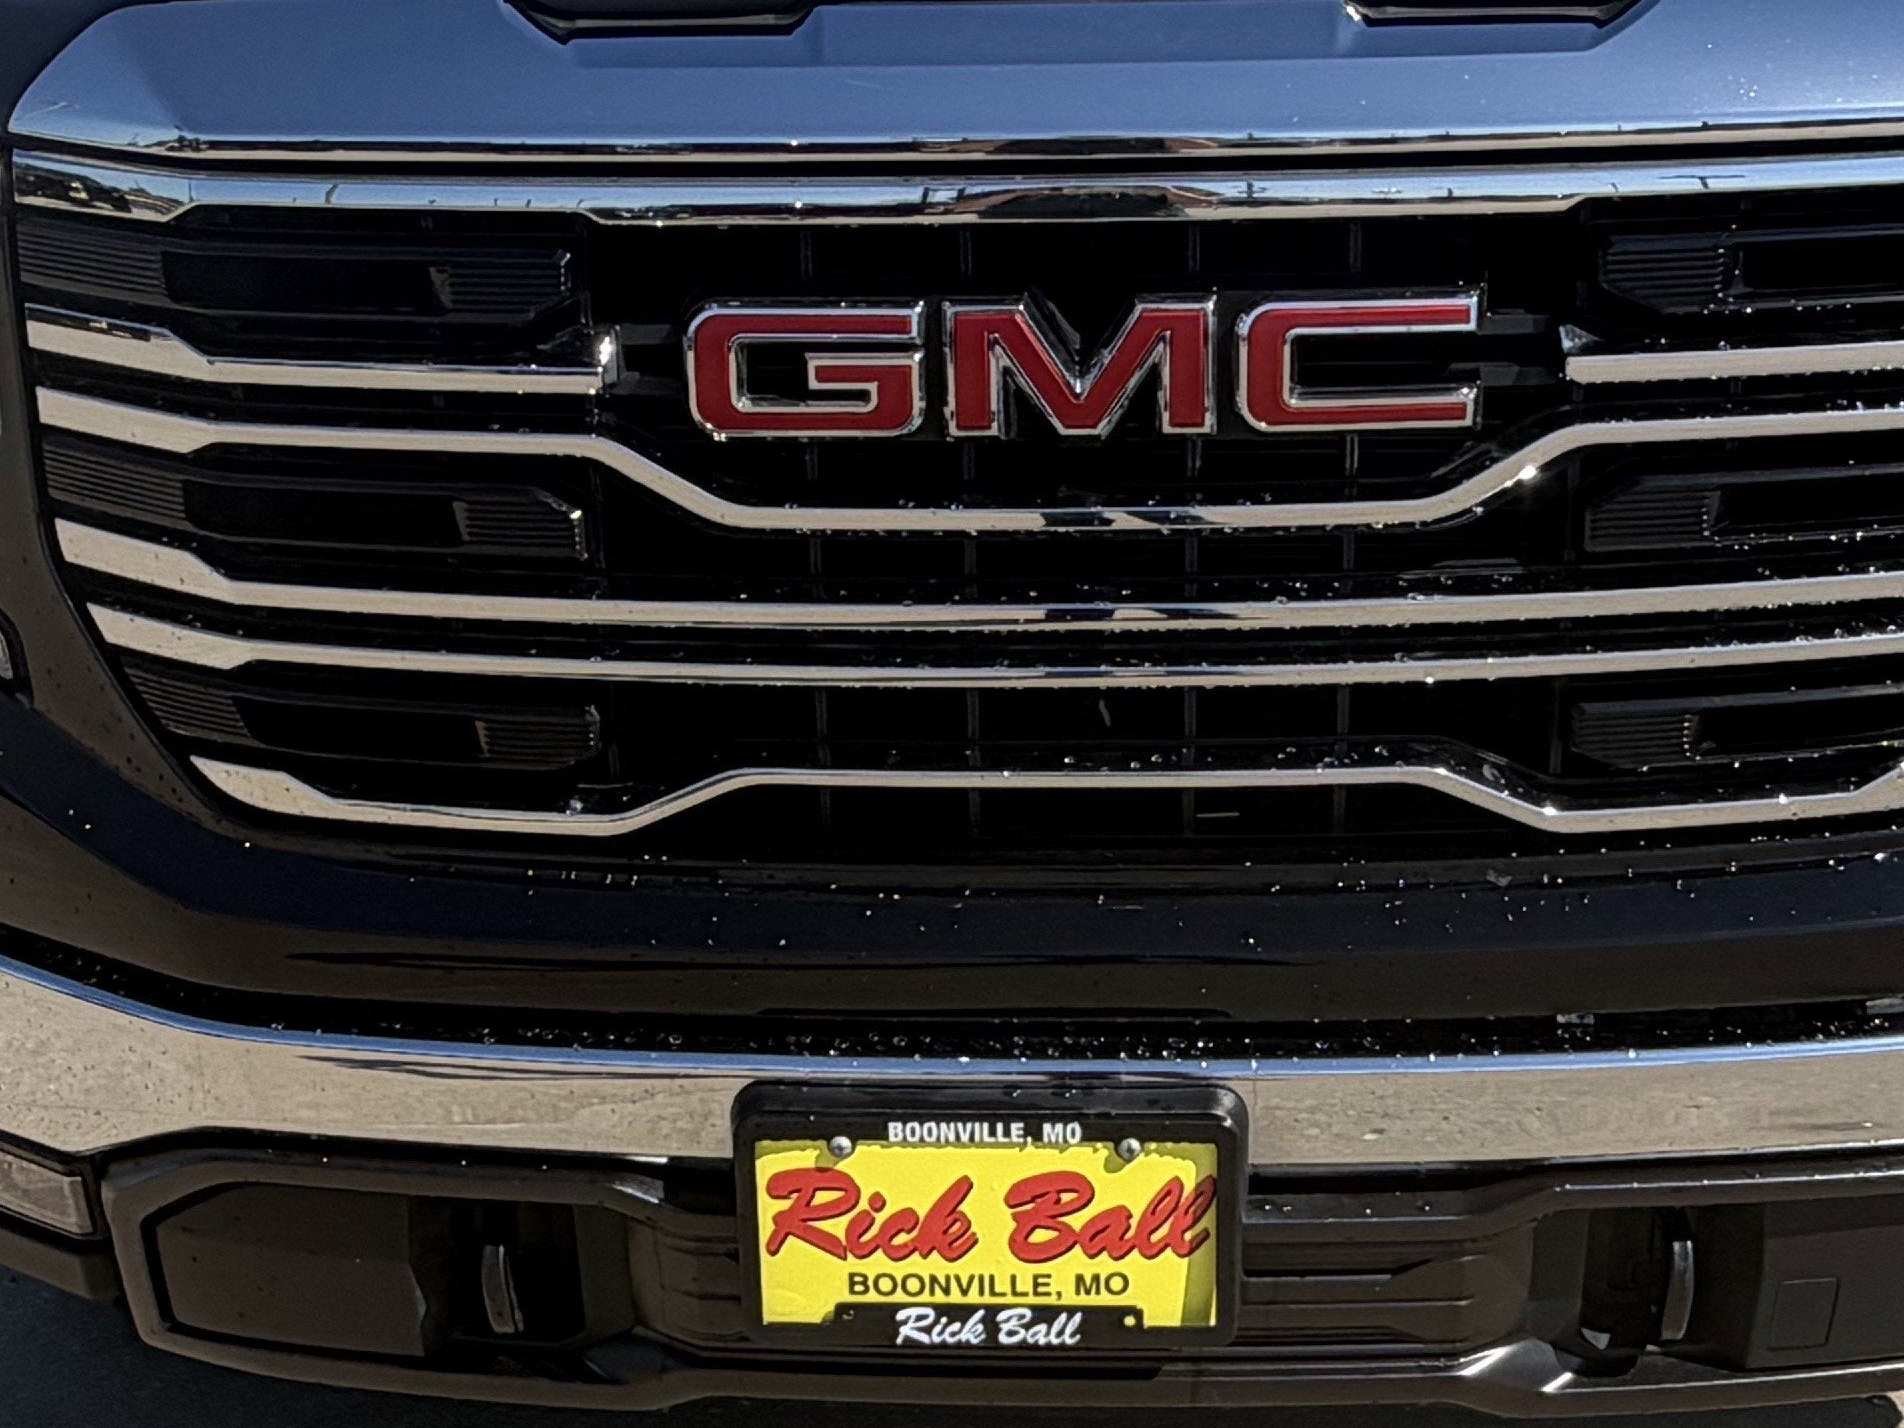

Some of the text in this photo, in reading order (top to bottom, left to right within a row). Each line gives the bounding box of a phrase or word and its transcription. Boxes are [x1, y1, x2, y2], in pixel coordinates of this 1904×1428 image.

[686, 285, 1482, 440] GMC
[888, 1121, 1082, 1146] BOONVILLE, MO
[765, 1167, 1218, 1264] Rick Ball
[847, 1272, 1131, 1301] BOONVILLE, MO
[896, 1306, 1083, 1346] Rick Ball
